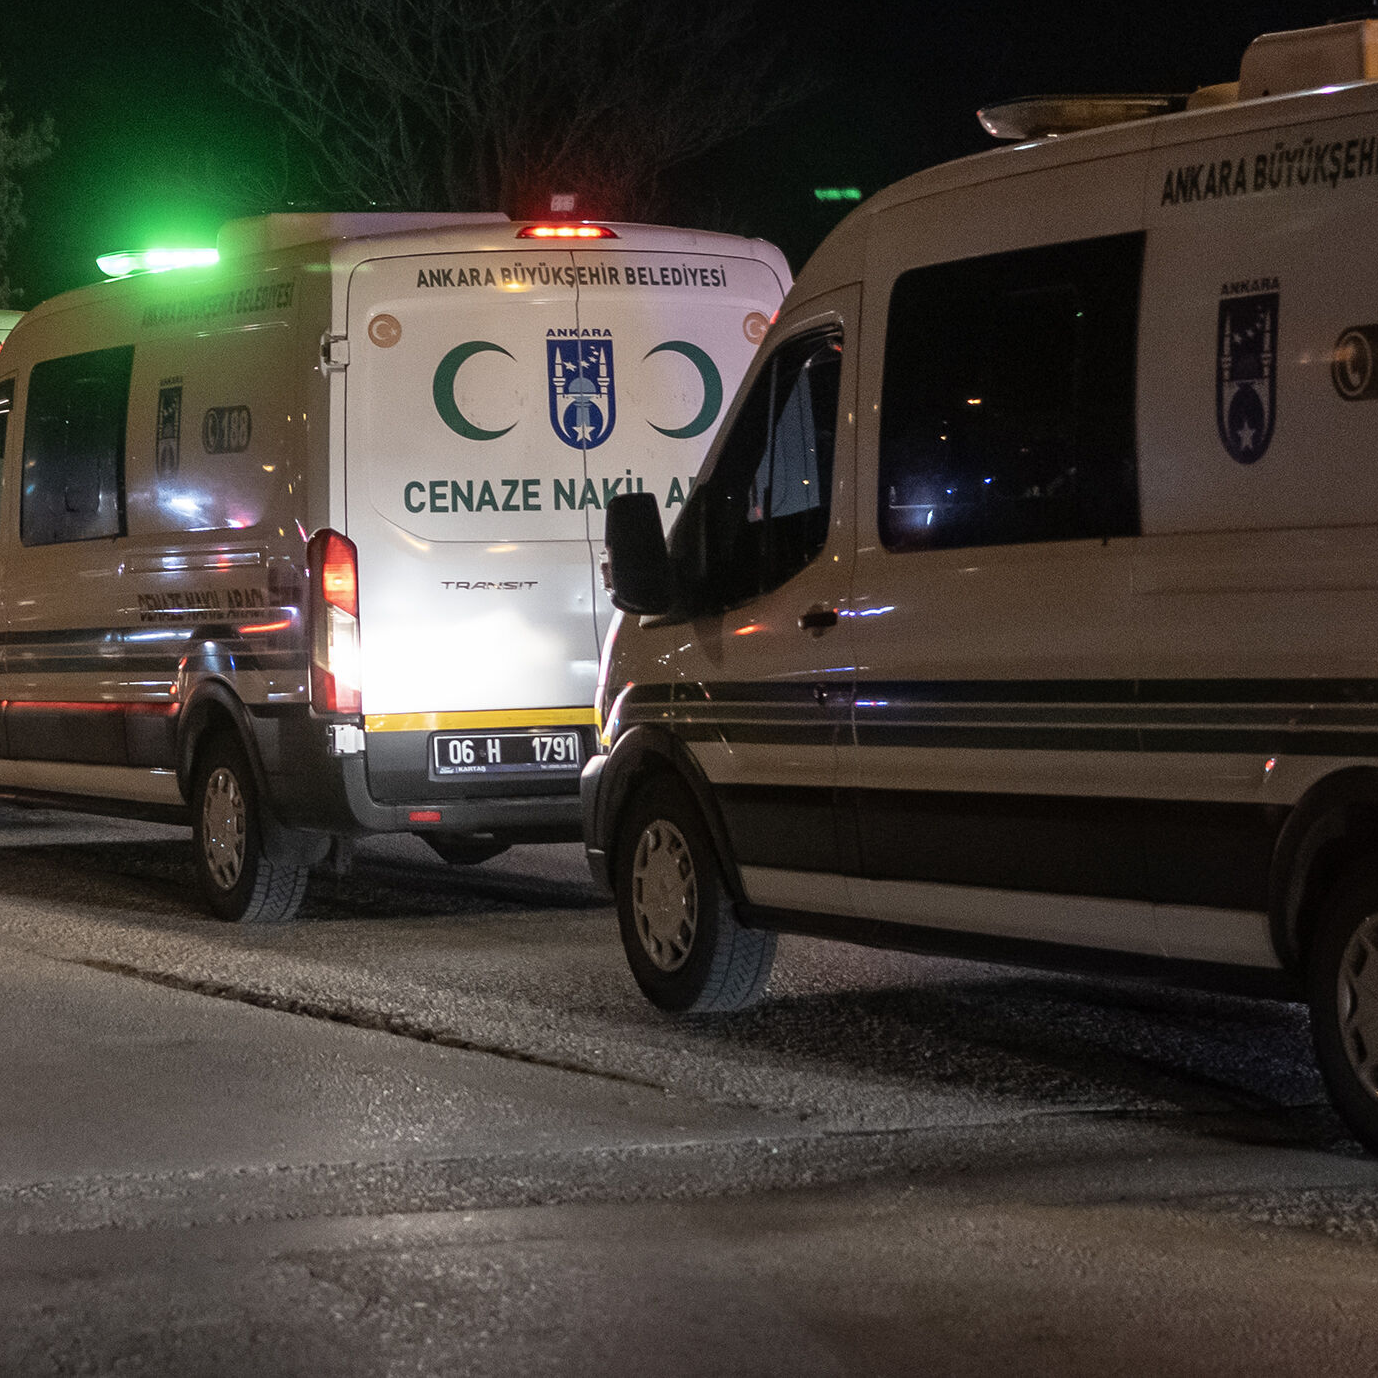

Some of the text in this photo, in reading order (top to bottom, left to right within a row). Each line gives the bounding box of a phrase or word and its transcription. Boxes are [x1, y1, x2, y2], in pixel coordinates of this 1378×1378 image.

[1160, 157, 1247, 207] ANKARA
[416, 261, 728, 290] ANKARA BÜYÜKŞEHİR BELEDİYESİ
[1221, 277, 1281, 296] ANKARA
[545, 328, 613, 337] ANKARA
[222, 410, 249, 450] 188
[403, 478, 542, 513] CENAZE
[440, 581, 538, 590] TRANSIT
[448, 736, 575, 765] 06 H 1791
